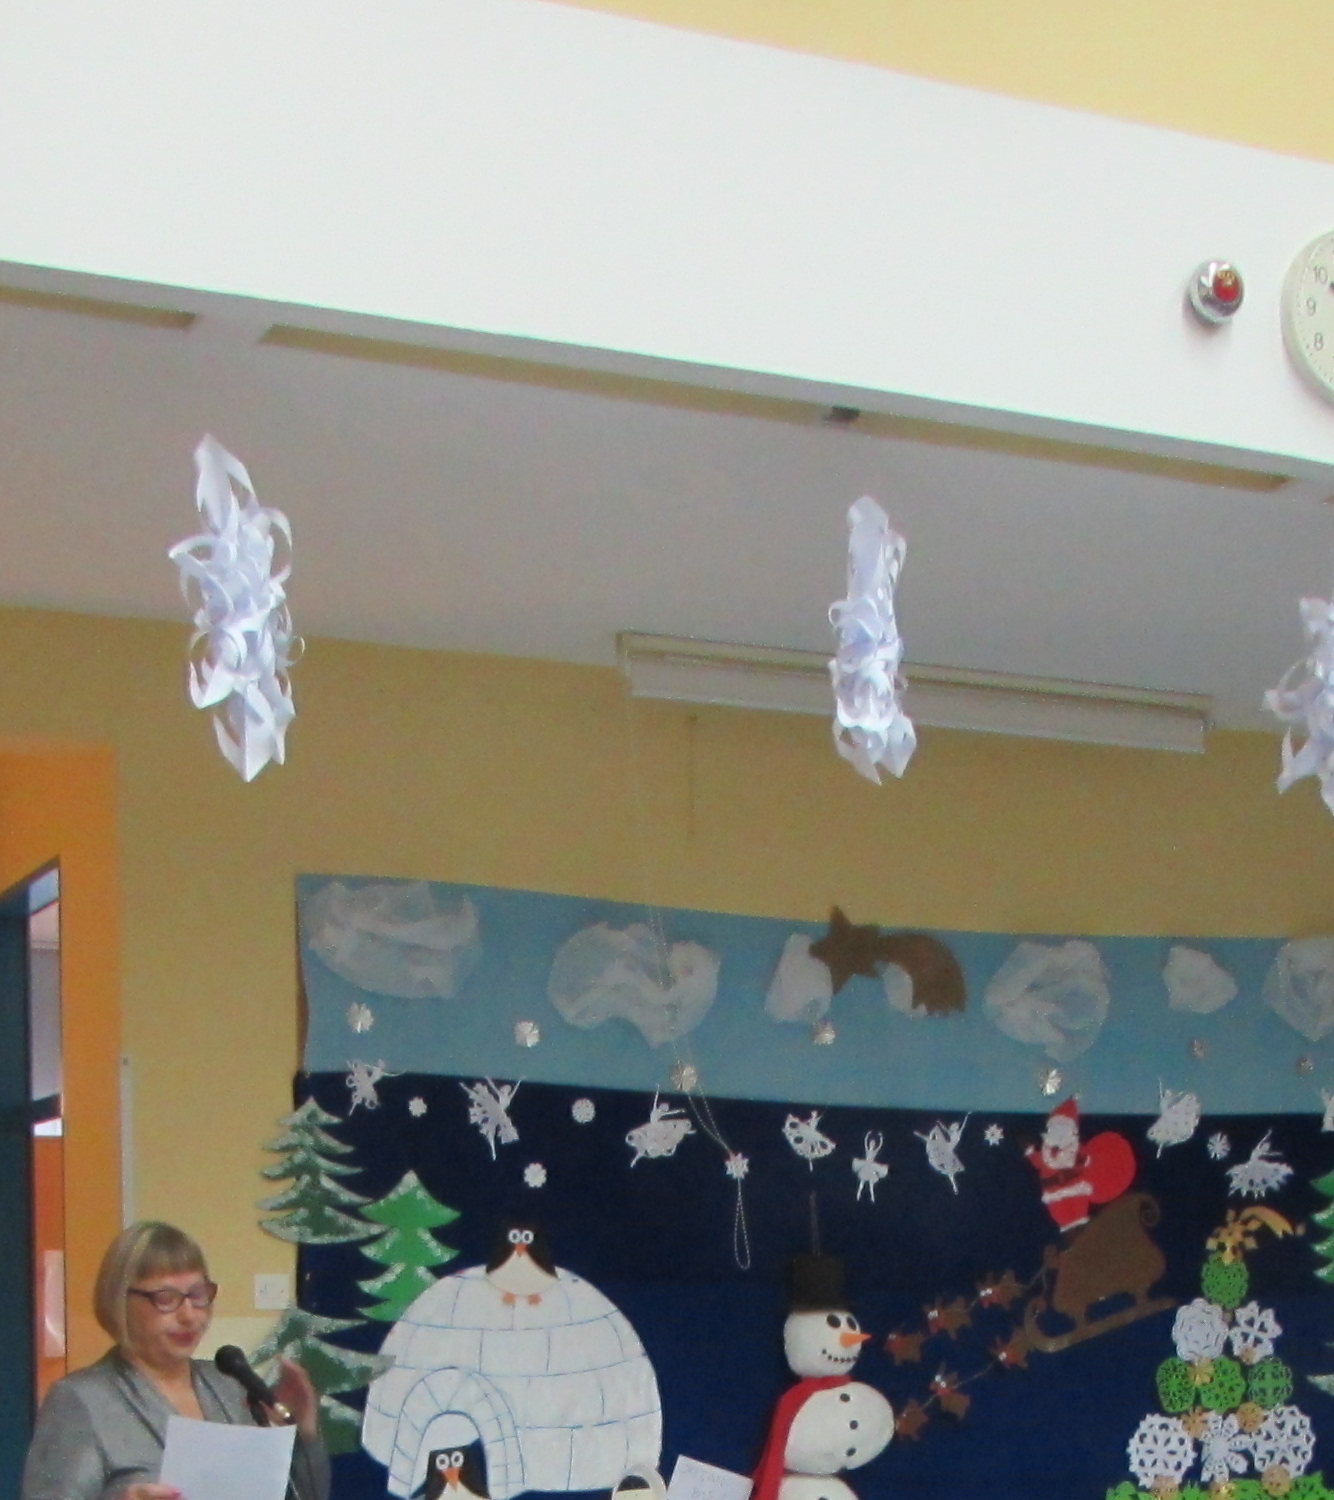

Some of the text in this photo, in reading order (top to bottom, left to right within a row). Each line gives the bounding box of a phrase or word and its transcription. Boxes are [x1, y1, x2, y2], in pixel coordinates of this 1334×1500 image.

[1313, 265, 1328, 285] 10
[1306, 297, 1317, 316] 9
[1313, 332, 1324, 351] 8
